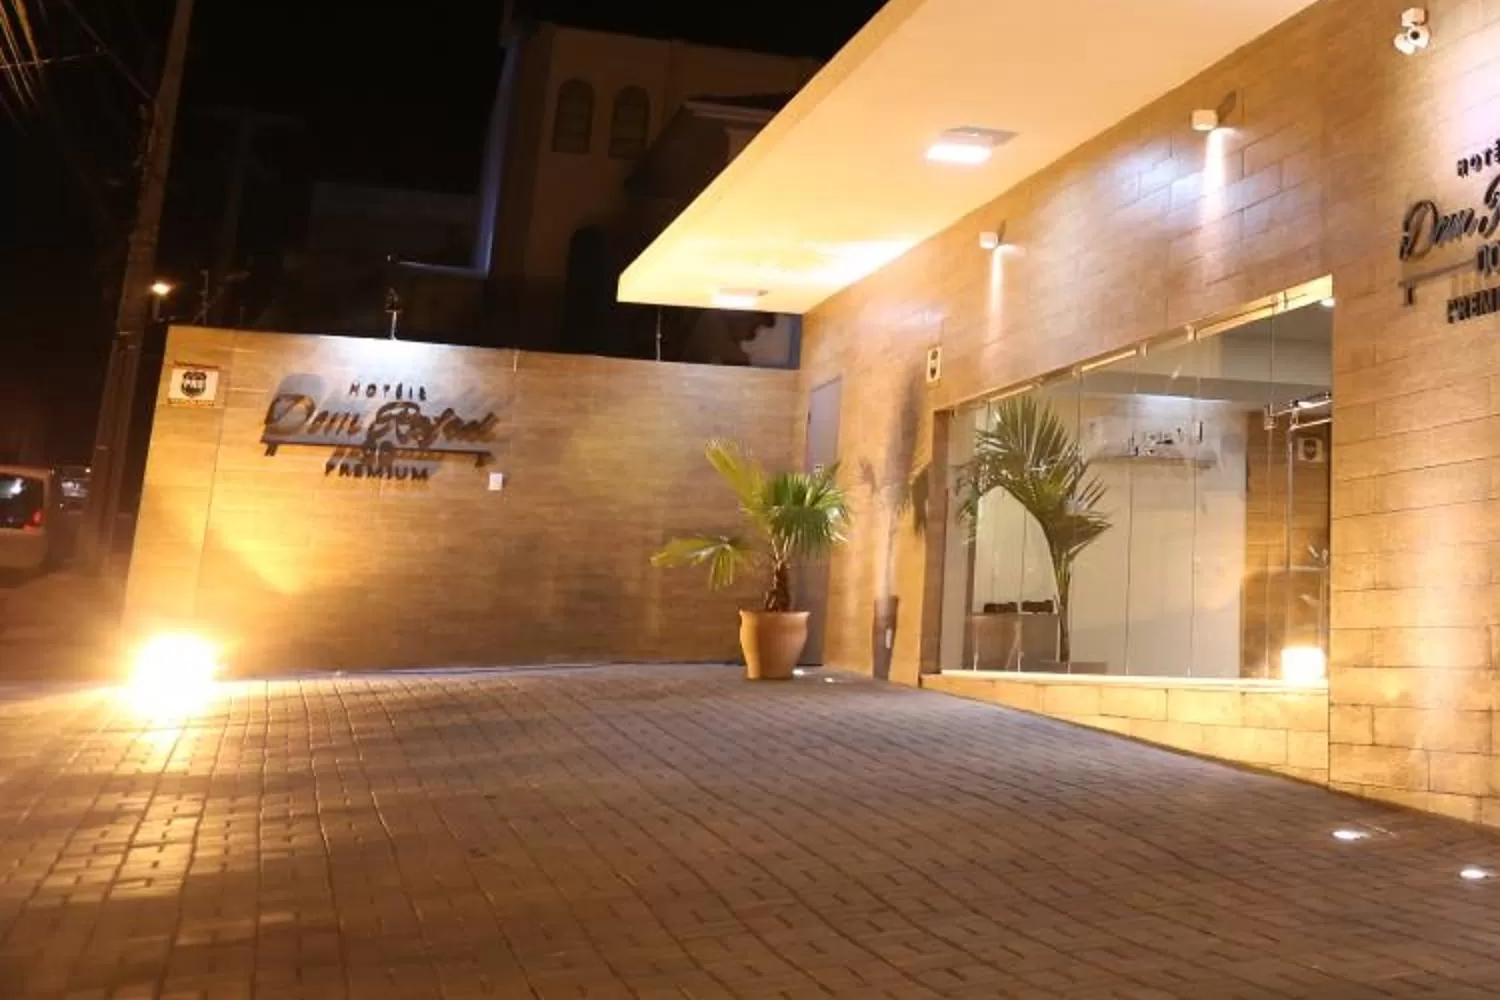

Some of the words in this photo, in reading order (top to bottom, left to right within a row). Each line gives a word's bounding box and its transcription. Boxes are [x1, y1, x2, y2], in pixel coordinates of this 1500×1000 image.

[1398, 199, 1476, 261] Dom
[262, 393, 363, 438] Dom
[364, 400, 502, 450] Rafael
[324, 462, 431, 481] PREMIUM
